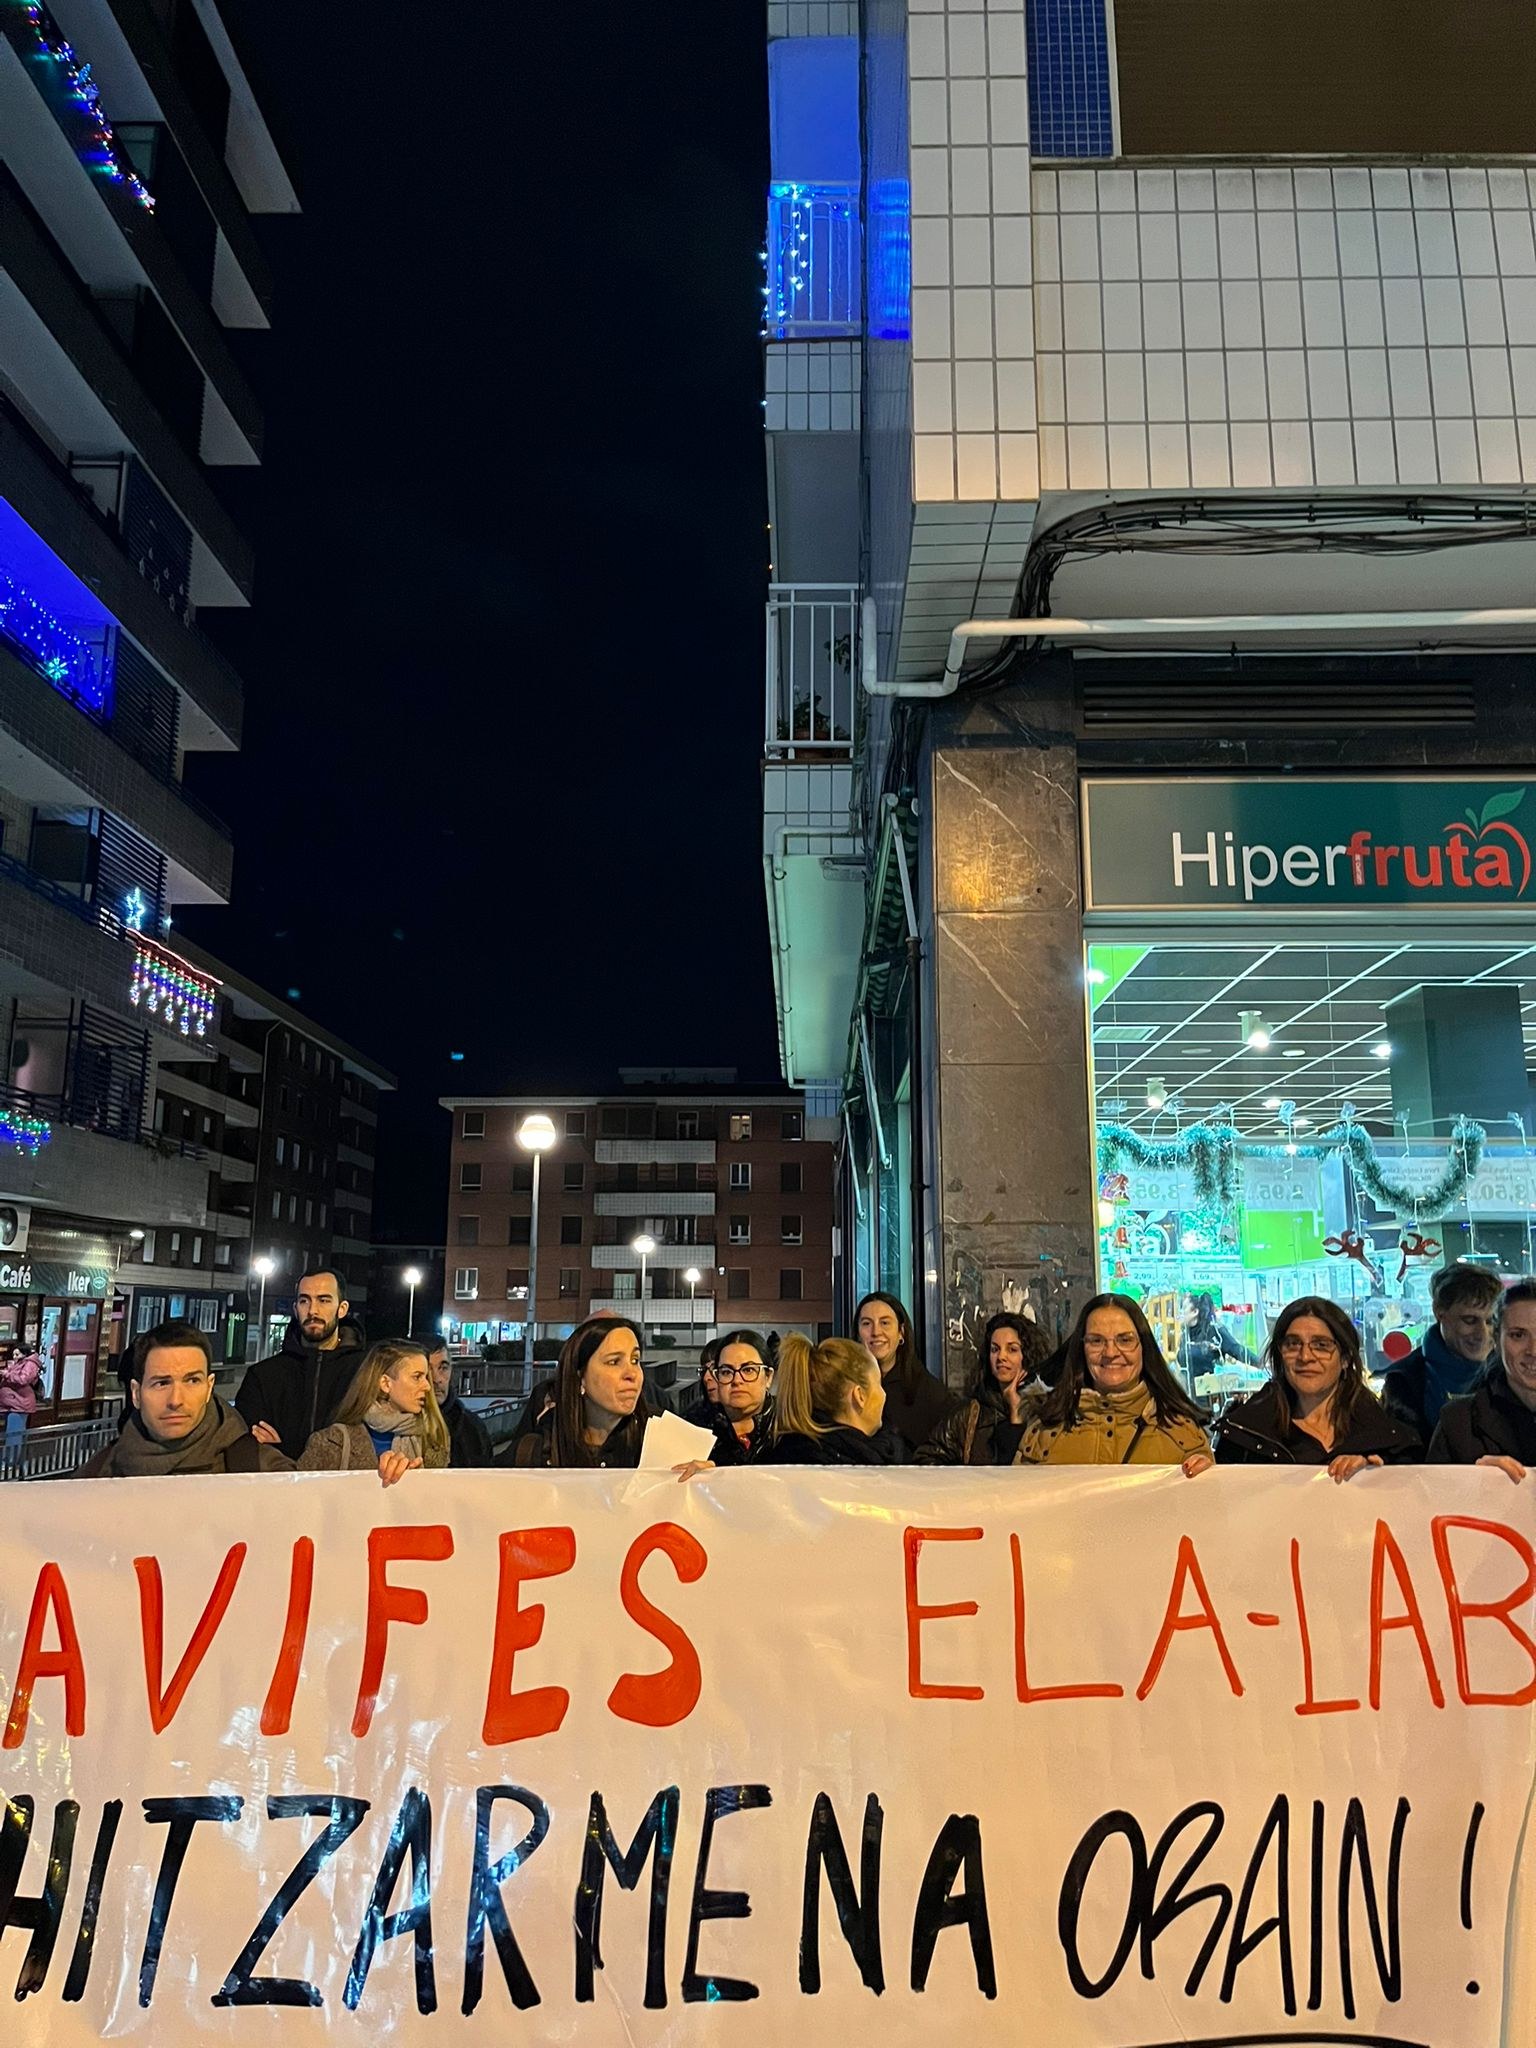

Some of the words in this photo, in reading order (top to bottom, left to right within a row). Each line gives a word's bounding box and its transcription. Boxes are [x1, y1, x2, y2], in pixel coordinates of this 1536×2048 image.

[1172, 831, 1513, 900] Hiperfruta
[0, 1264, 32, 1289] Café
[68, 1271, 91, 1293] Iker
[3, 1521, 708, 1749] AVIFES
[0, 1784, 998, 2017] HITZARMENA
